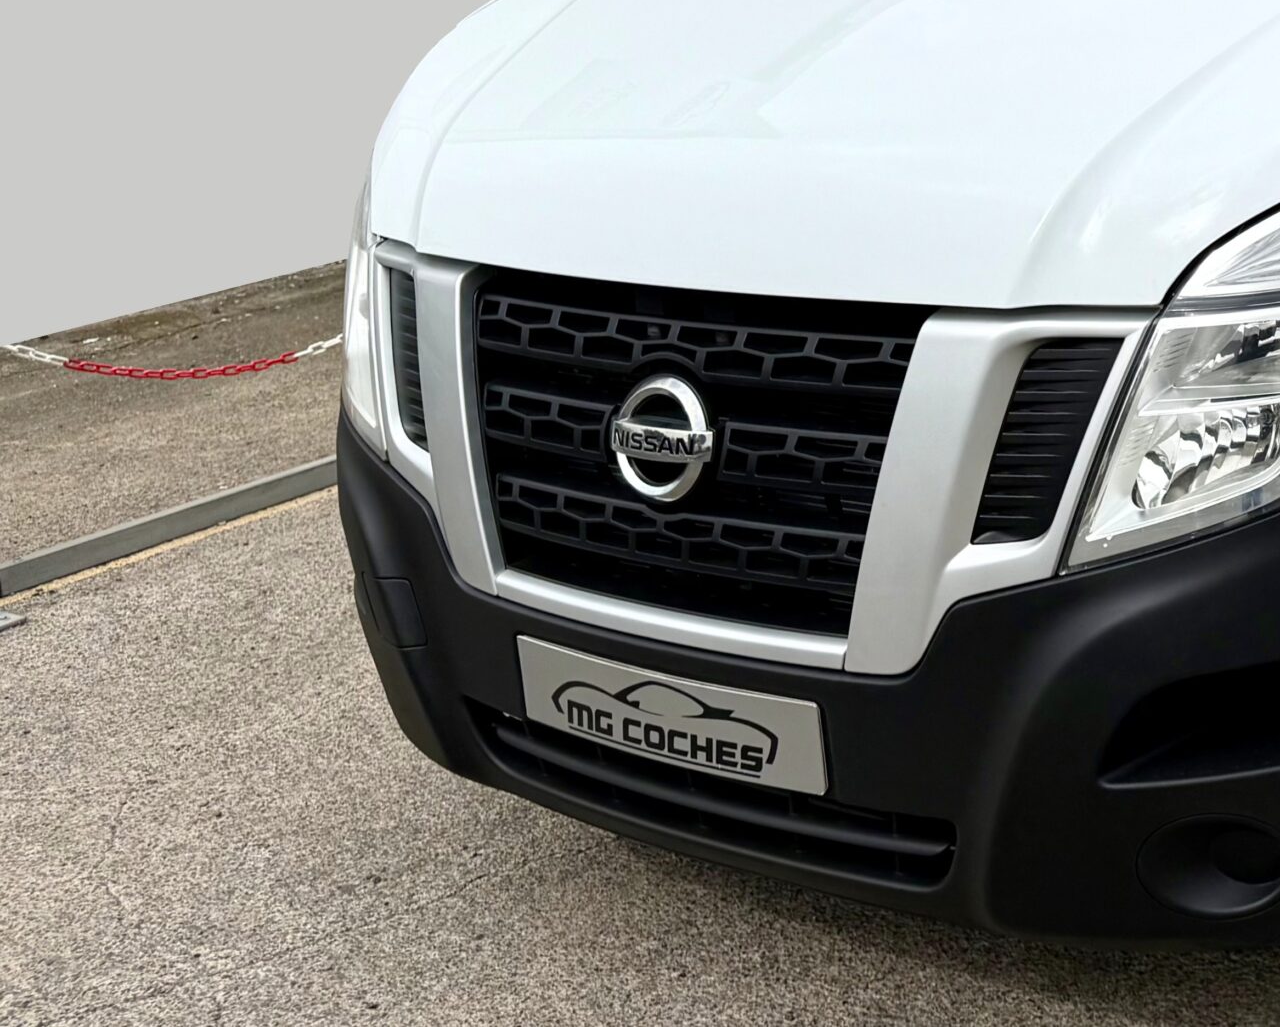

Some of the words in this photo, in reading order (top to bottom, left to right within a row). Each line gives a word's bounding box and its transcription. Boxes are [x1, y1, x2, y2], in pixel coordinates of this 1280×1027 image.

[613, 427, 696, 456] NISSAN
[567, 699, 614, 737] MG
[622, 720, 764, 772] COCHES
